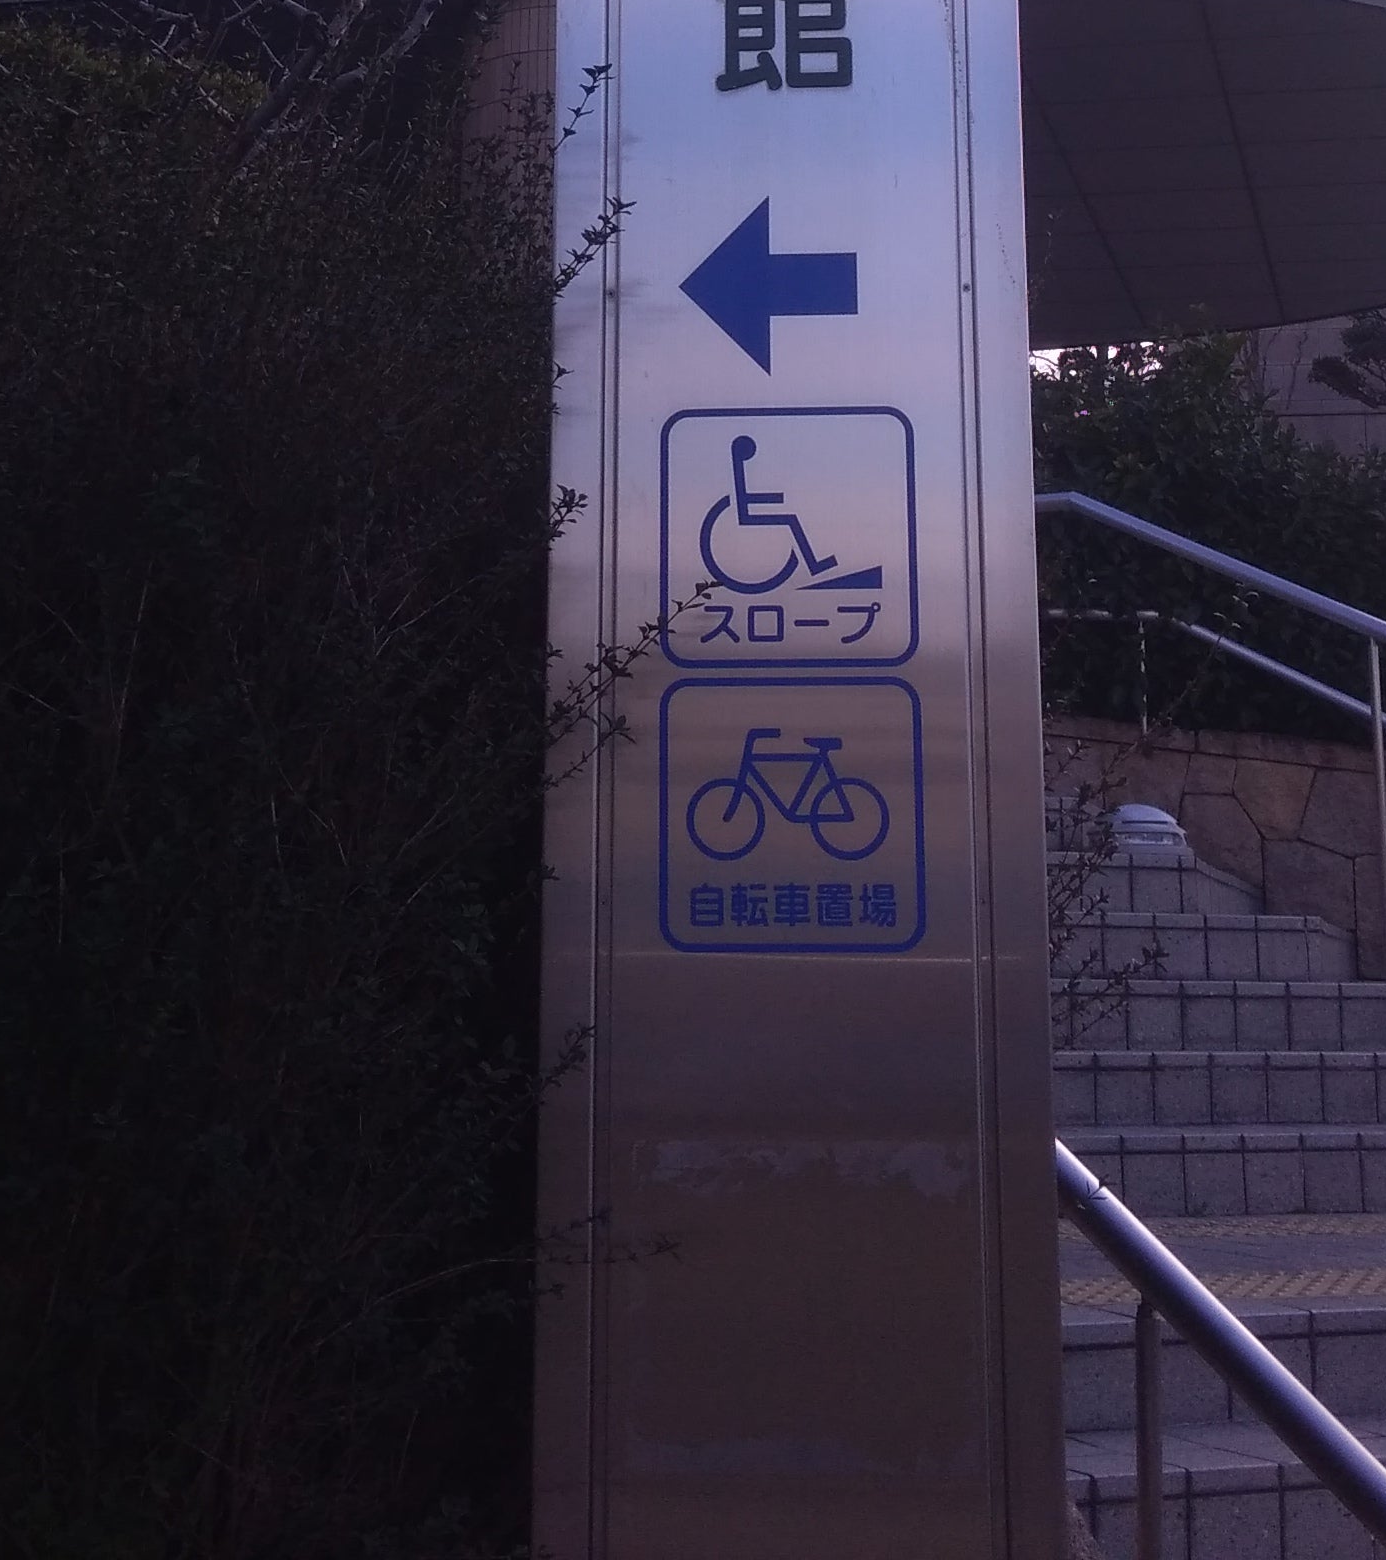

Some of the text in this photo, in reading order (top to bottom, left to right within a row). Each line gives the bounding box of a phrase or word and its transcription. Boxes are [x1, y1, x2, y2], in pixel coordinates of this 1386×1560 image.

[700, 600, 882, 644] スロープ
[689, 882, 898, 928] 自転車置場
